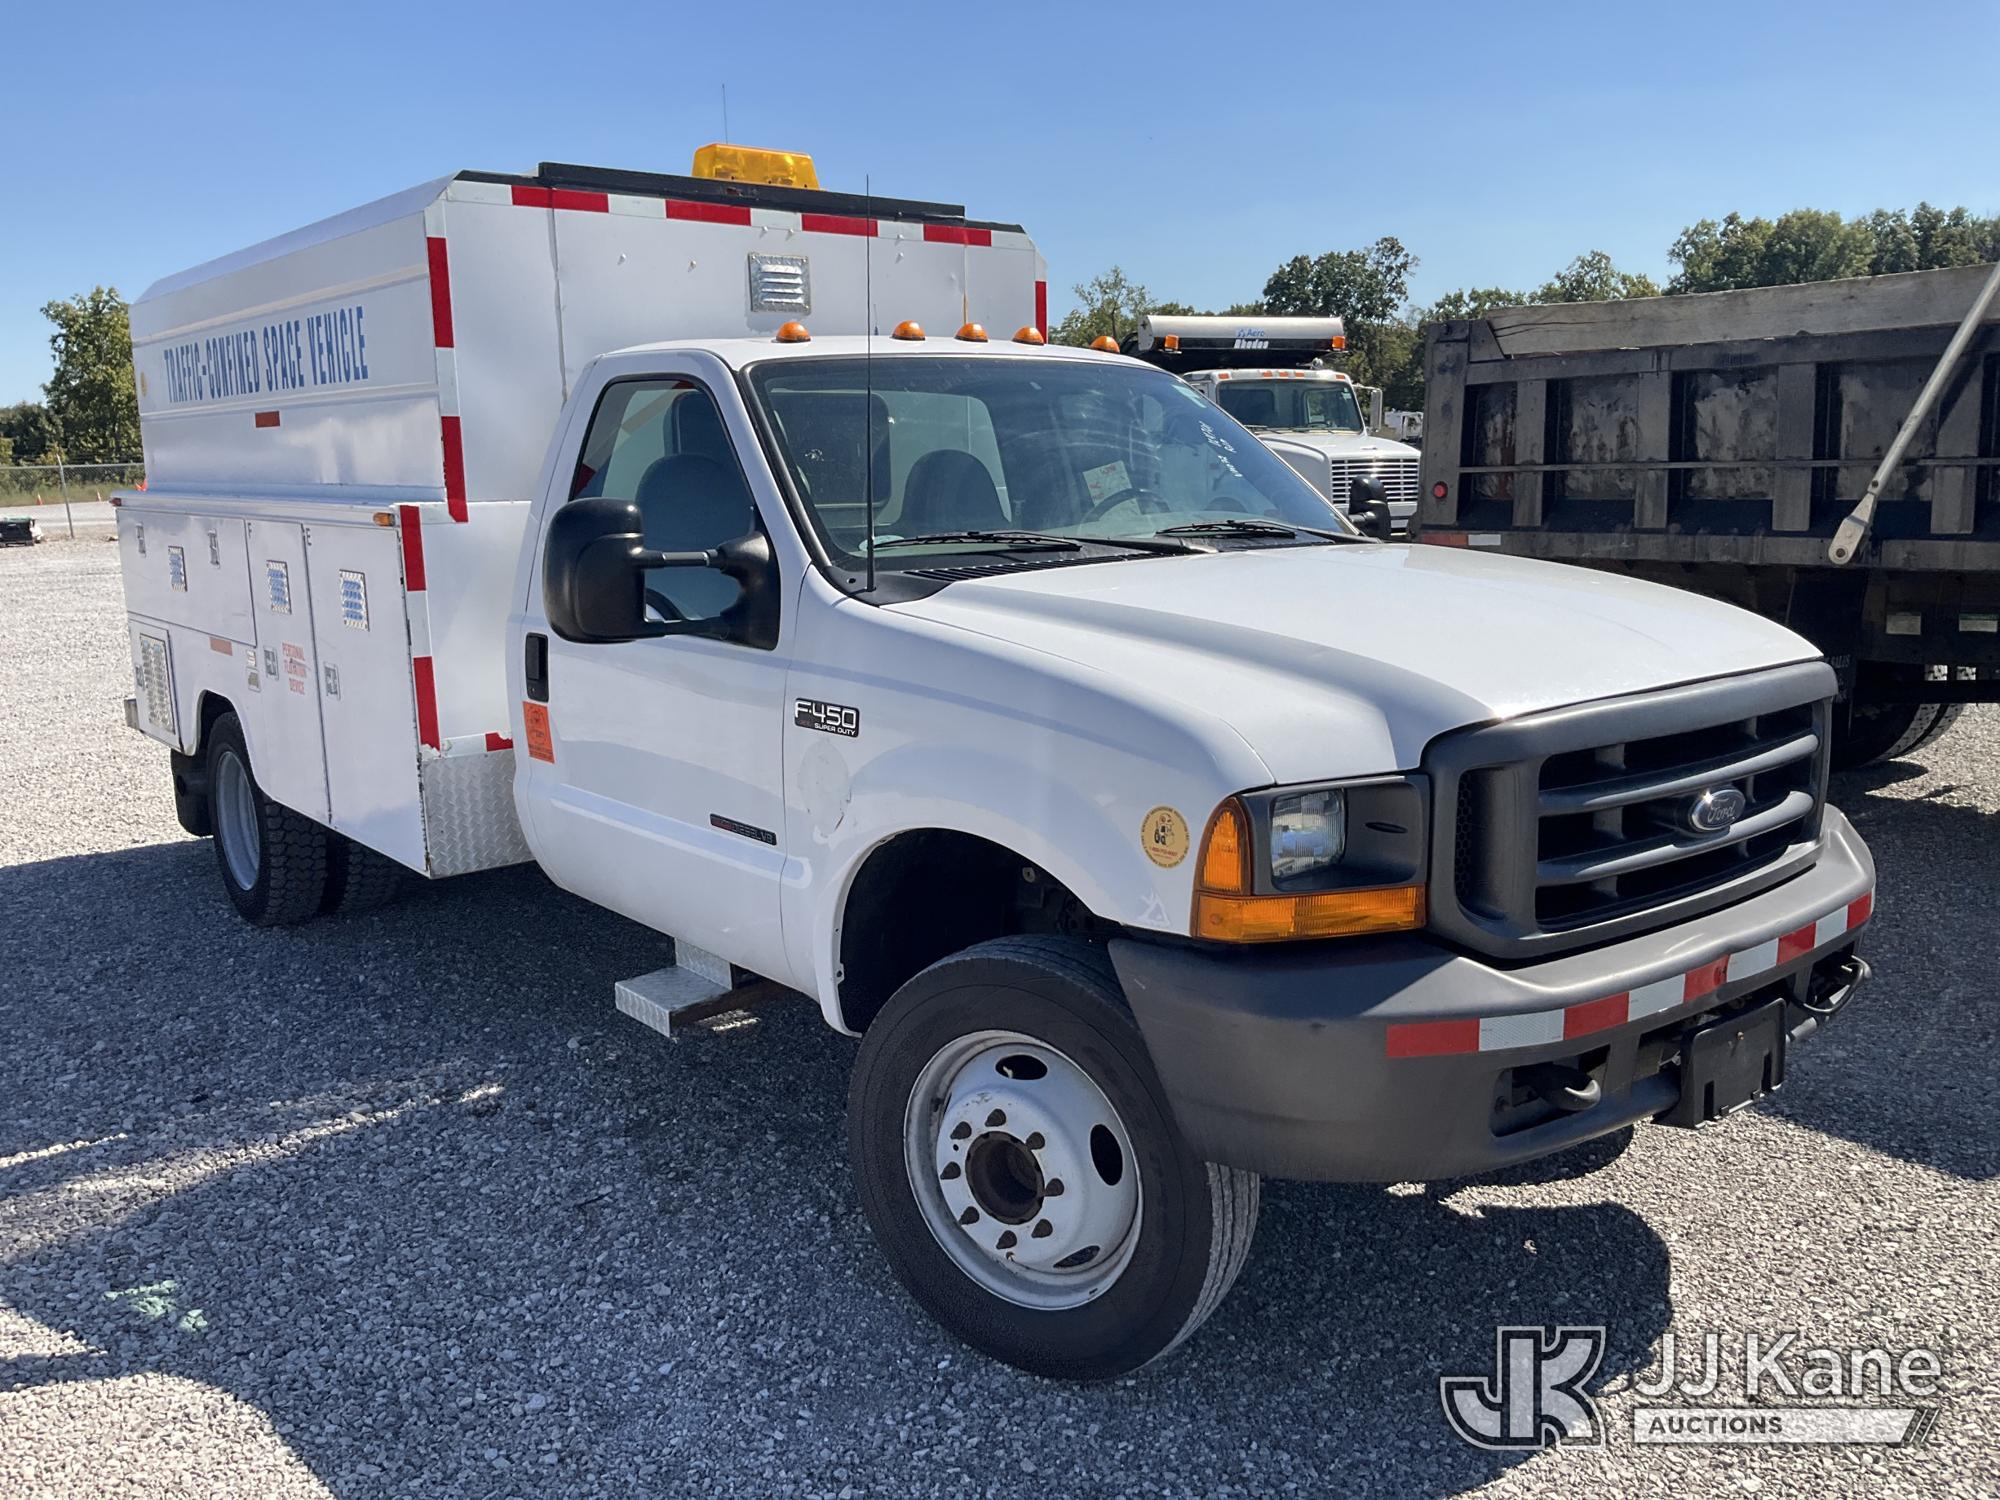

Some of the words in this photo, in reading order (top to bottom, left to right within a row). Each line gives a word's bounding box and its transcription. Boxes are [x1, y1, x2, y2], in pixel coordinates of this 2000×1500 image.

[164, 329, 260, 403] TRAFFIC-CONFINED
[263, 320, 305, 392] SPACE
[307, 306, 369, 386] VEHICLE
[814, 722, 836, 733] SUPER
[837, 727, 856, 736] DUTY
[1707, 797, 1737, 823] Ford
